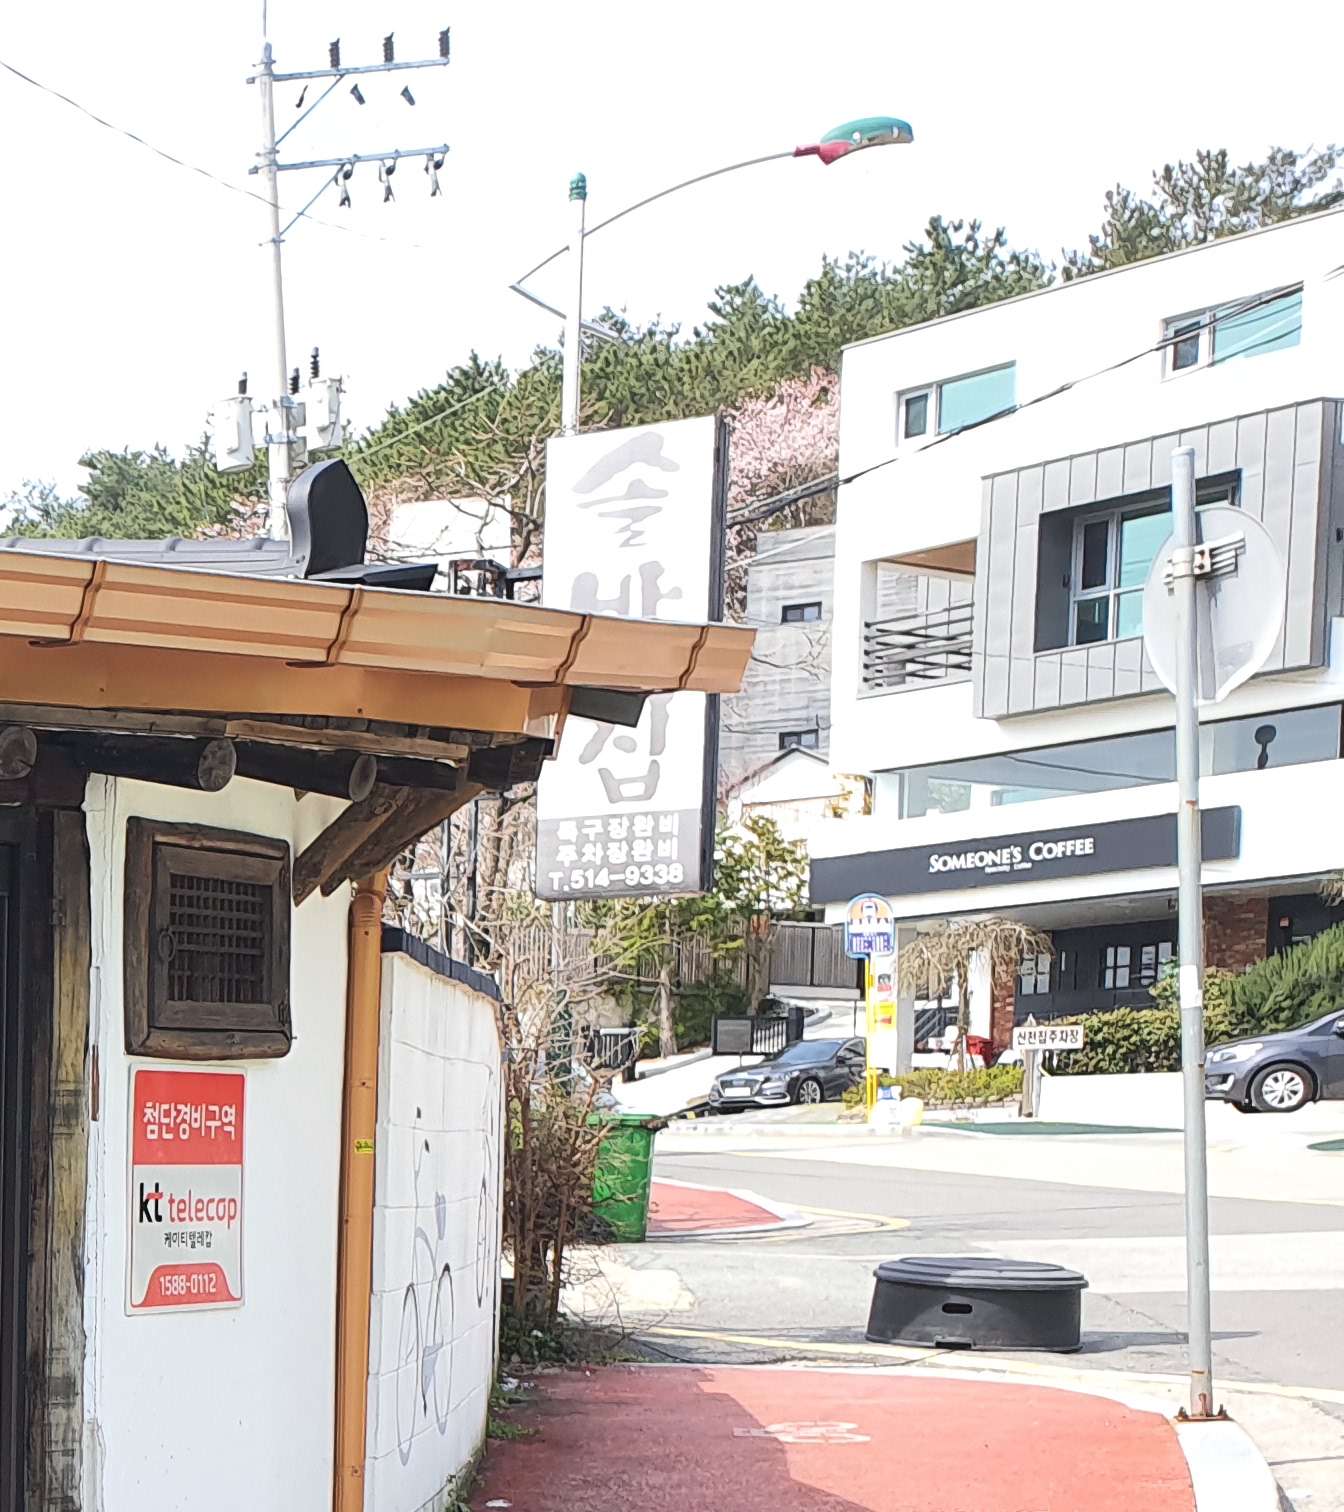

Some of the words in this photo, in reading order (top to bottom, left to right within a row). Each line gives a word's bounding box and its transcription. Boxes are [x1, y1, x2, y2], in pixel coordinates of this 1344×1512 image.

[928, 845, 1022, 873] SOMEONE'S
[1028, 837, 1094, 861] COFFEE
[548, 862, 684, 892] T.514-9338
[143, 1101, 236, 1140] 첨단경비구역
[167, 1189, 238, 1230] telecop
[159, 1273, 217, 1296] 1588-0112
